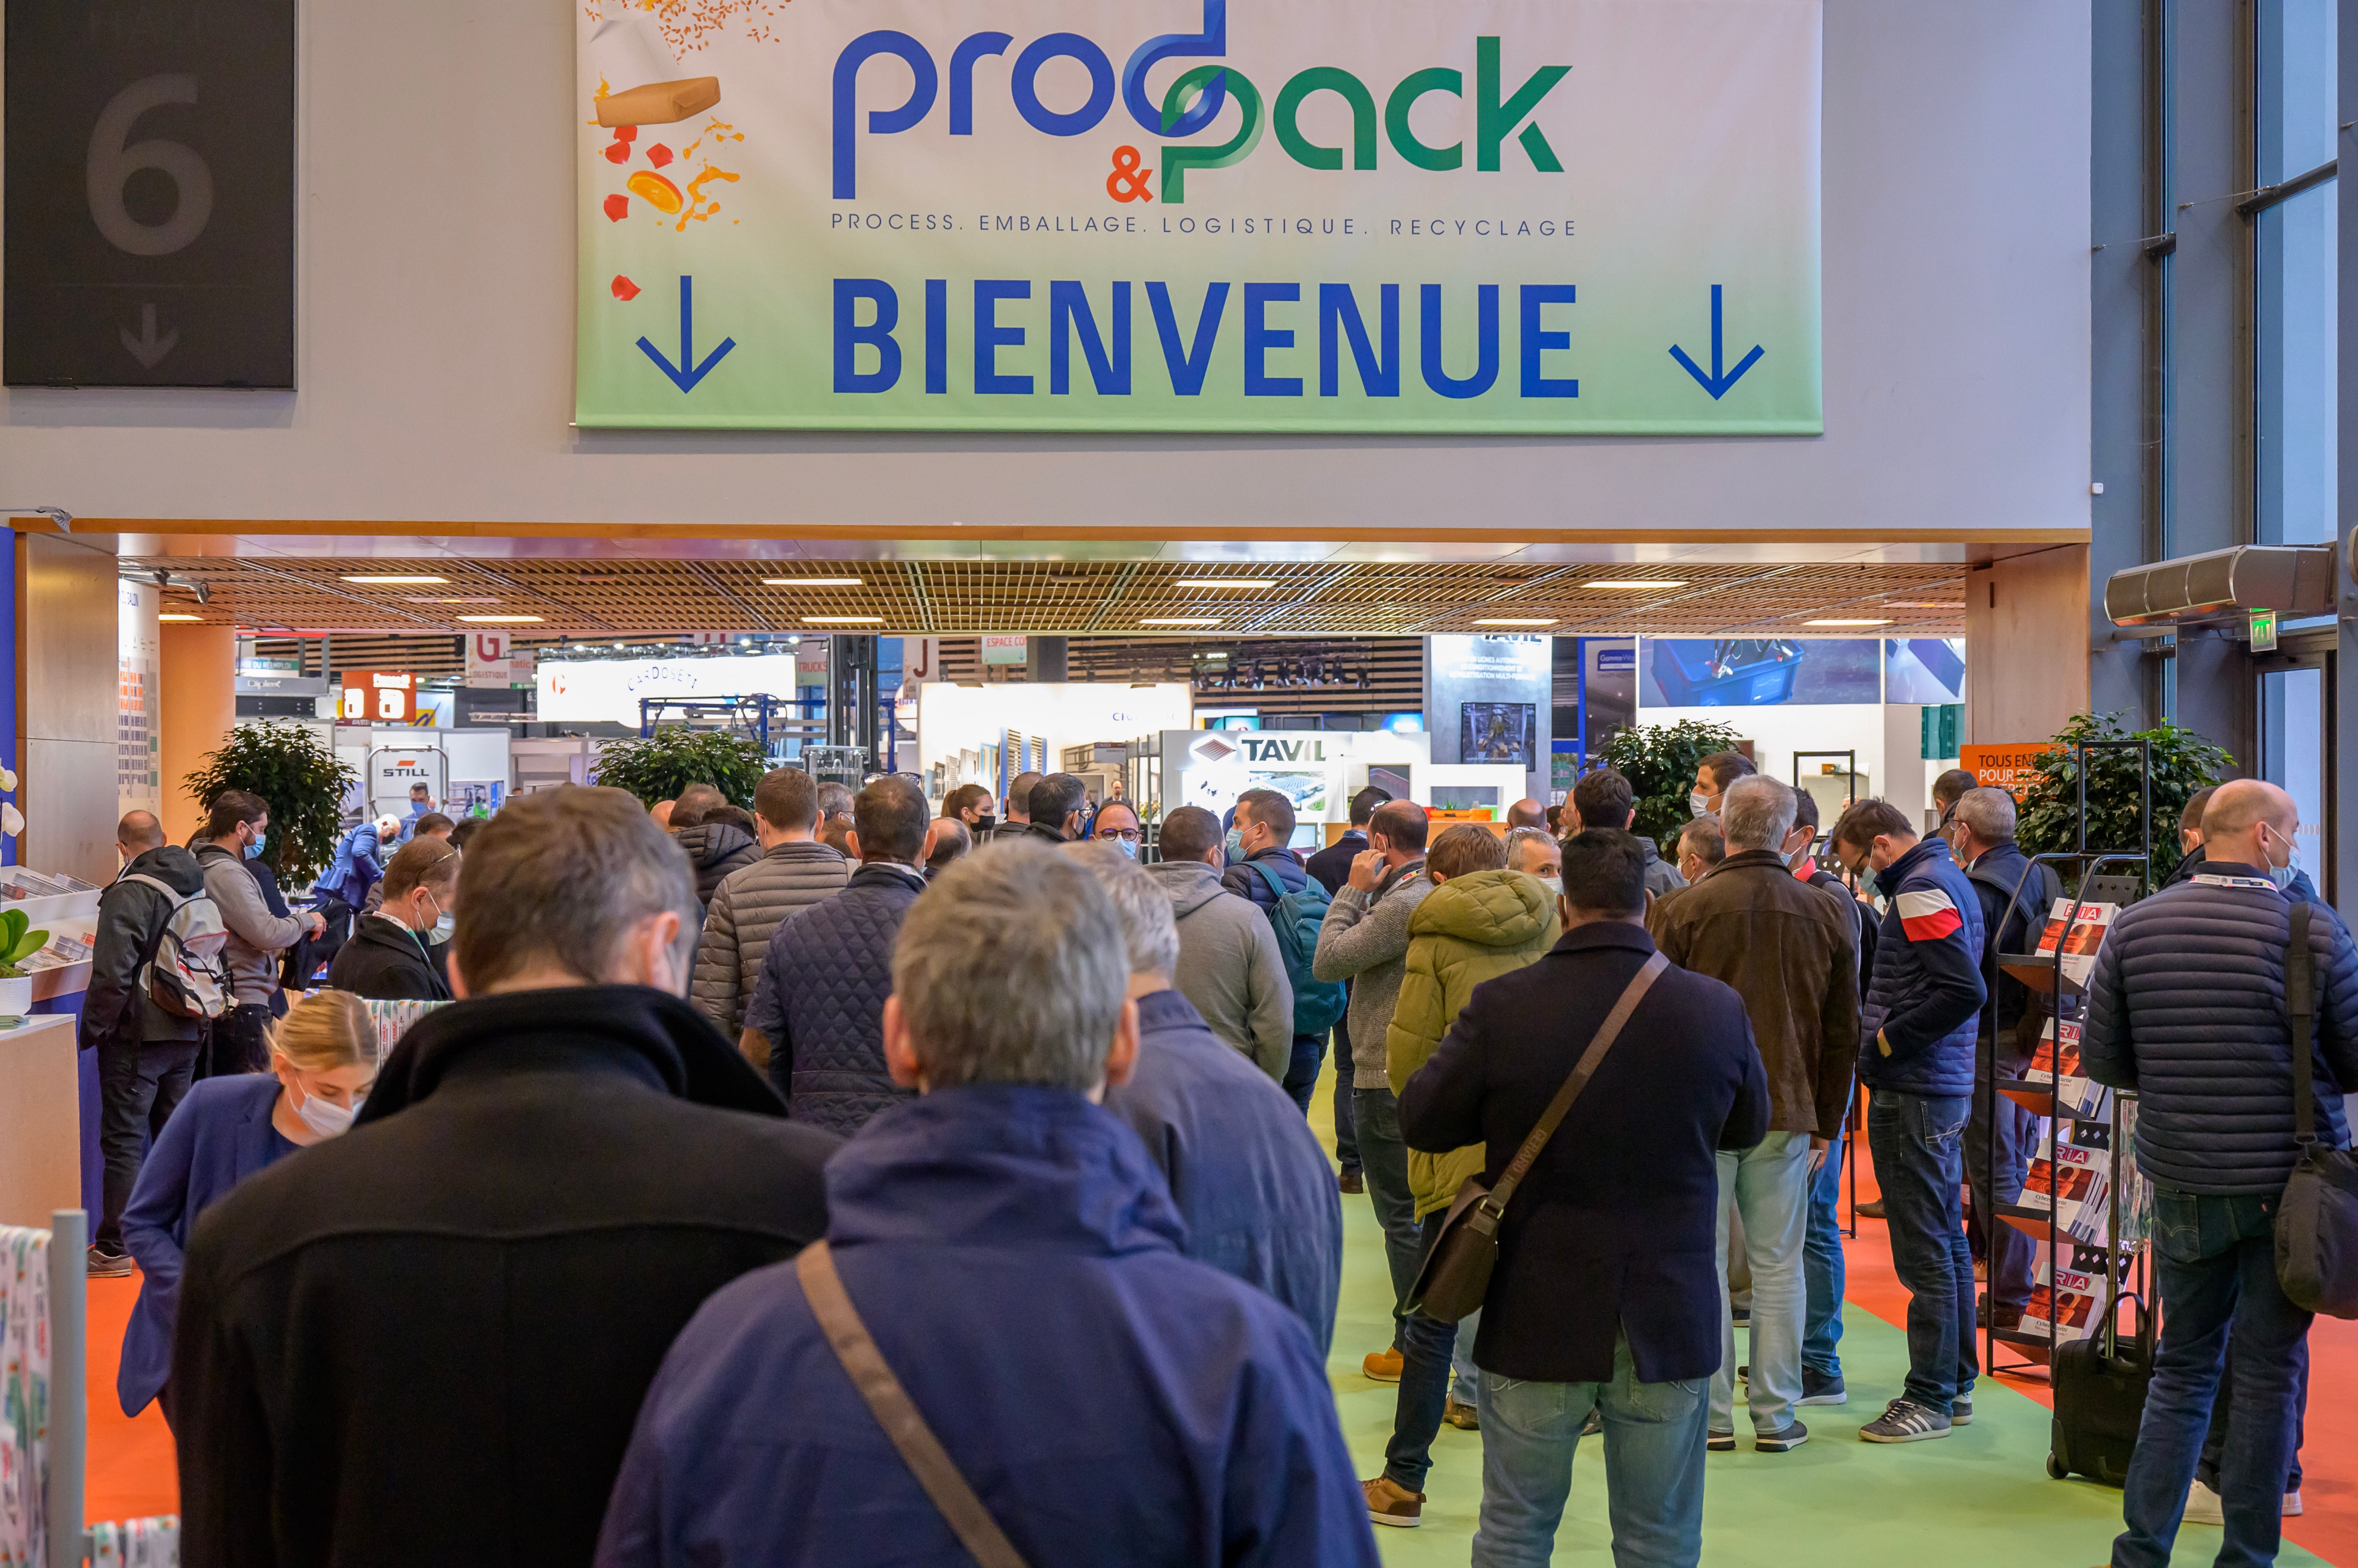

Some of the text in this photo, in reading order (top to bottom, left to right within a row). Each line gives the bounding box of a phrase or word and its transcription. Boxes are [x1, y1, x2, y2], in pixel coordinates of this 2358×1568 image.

[86, 73, 214, 256] 6
[832, 214, 1576, 236] PROCESS. EMBALLAGE. LOGISTIQUE. RECYCLAGE
[833, 279, 1580, 400] BIENVENUE
[987, 637, 1013, 647] ESPACE
[913, 638, 928, 678] J
[798, 661, 827, 672] TRUCKS
[469, 671, 508, 679] LOGISTIQUE
[247, 679, 282, 690] Diplex
[1242, 739, 1326, 761] TAVIL
[1979, 754, 2012, 767] TOUS
[383, 768, 430, 777] STILL
[1979, 769, 2014, 782] POUR
